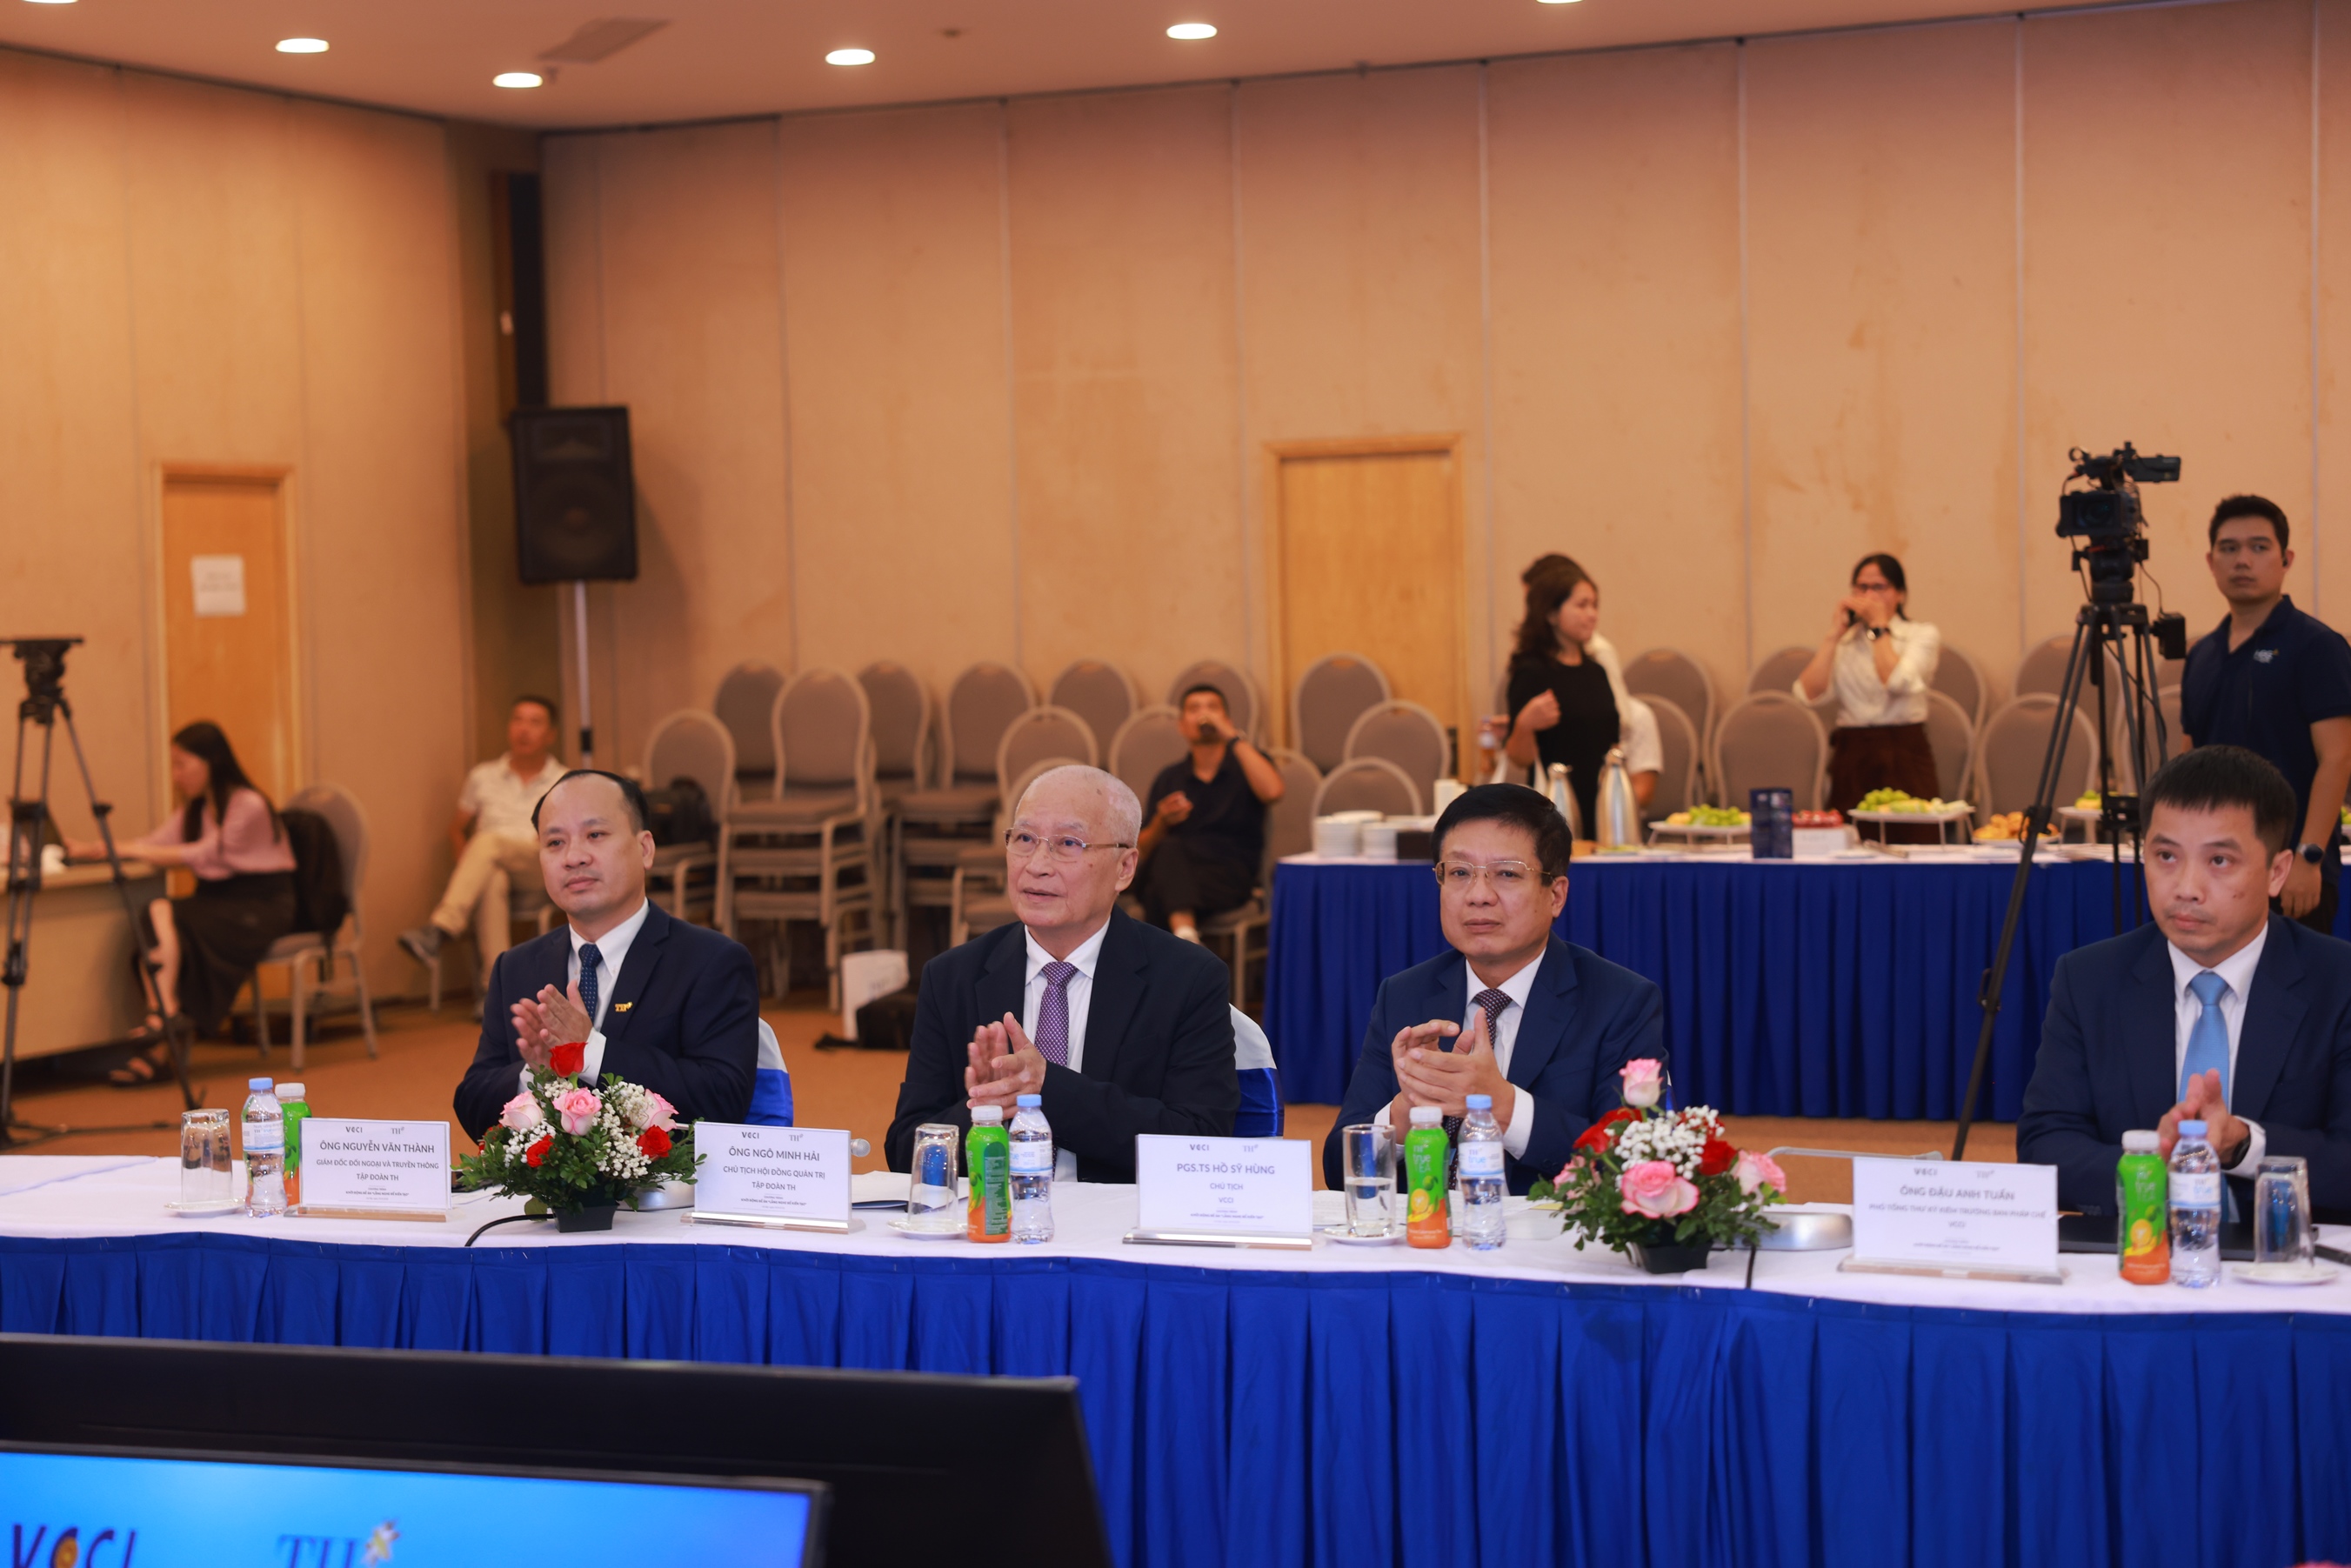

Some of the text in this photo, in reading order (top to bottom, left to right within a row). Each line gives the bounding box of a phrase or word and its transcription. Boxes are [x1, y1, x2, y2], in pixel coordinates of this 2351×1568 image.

[320, 1139, 435, 1153] ÔNG NGUYỄN VĂN THÀNH
[729, 1146, 820, 1161] ÔNG NGÔ MINH HẢI
[740, 1166, 756, 1175] TỊCH
[757, 1166, 770, 1176] HỘI
[771, 1166, 791, 1177] ĐỒNG
[793, 1168, 813, 1178] QUẢN
[1177, 1161, 1275, 1174] PGS.TS HỒ SỸ HÙNG
[751, 1181, 765, 1190] TẬP
[765, 1181, 785, 1191] ĐOÀN
[1210, 1181, 1226, 1190] CHỦ
[1900, 1184, 1926, 1196] ÔNG
[1955, 1189, 1980, 1198] ANH
